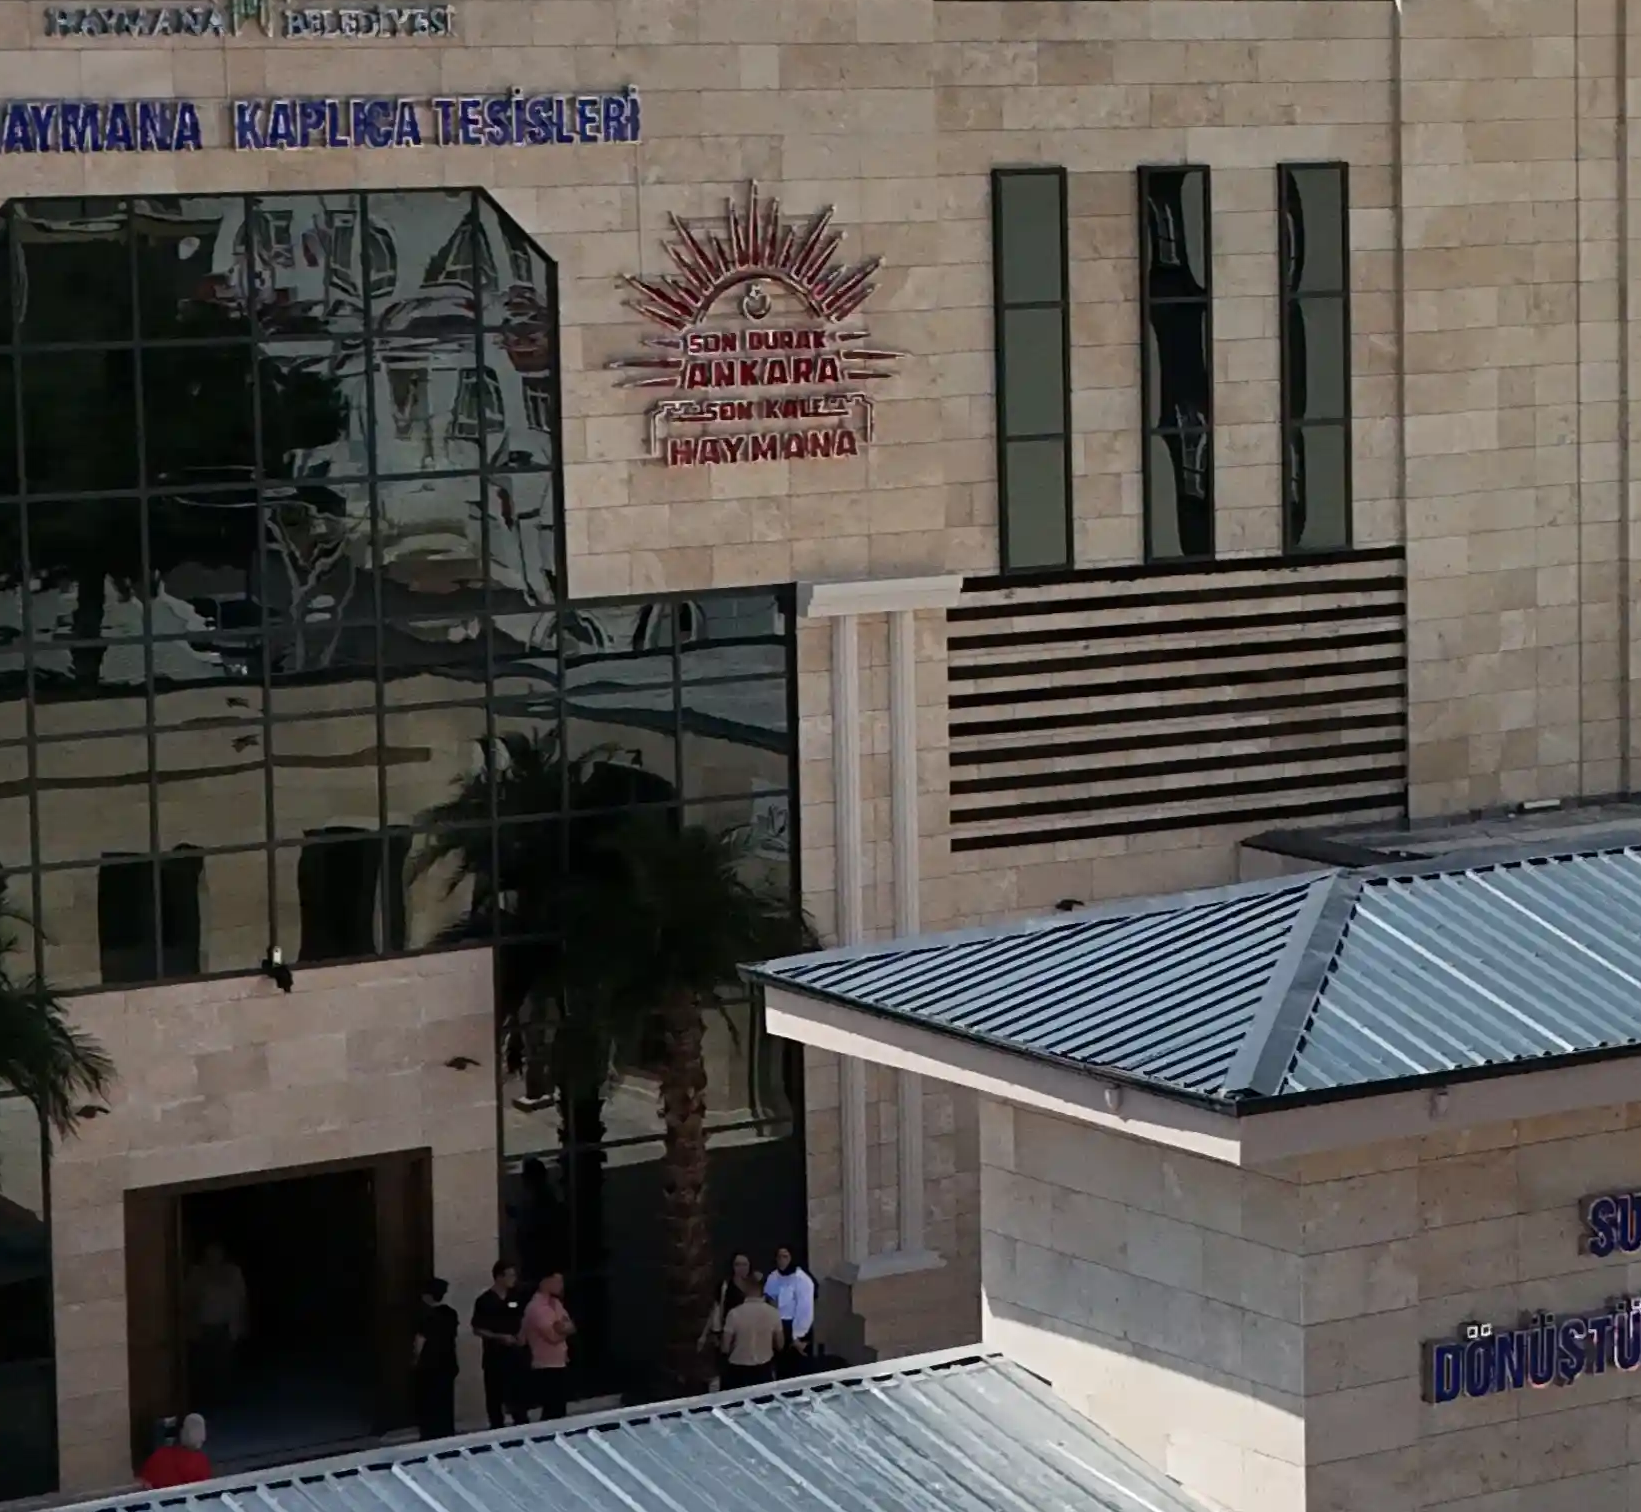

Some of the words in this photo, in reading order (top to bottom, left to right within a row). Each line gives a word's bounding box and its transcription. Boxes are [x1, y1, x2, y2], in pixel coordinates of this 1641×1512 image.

[46, 5, 227, 38] HAYMANA
[284, 3, 458, 39] BELEDİYESİ
[233, 98, 424, 152] KAPLICA
[430, 83, 642, 146] TESİSLERİ
[688, 332, 739, 355] SON
[746, 329, 827, 351] DURAK
[685, 354, 842, 389] ANKARA
[704, 399, 755, 422] SON
[762, 396, 825, 419] KALE
[667, 428, 859, 467] HAYMANA
